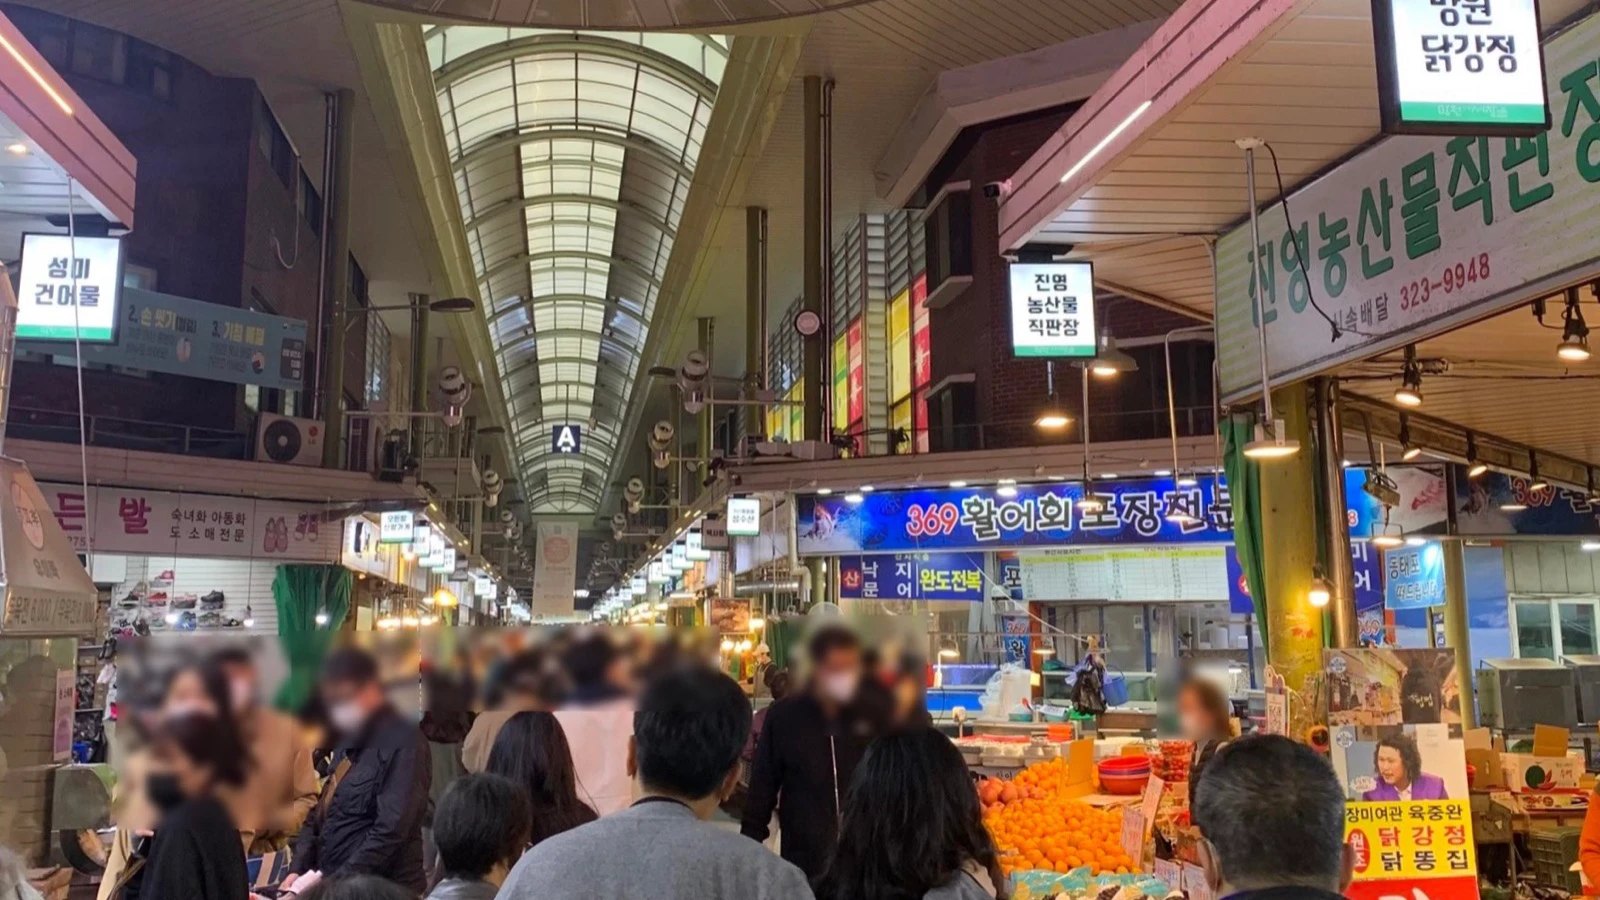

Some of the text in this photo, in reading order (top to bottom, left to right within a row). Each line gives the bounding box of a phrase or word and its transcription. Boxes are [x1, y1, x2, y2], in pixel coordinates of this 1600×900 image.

[1421, 35, 1518, 73] 닭강정
[48, 257, 91, 279] 성미
[1034, 273, 1068, 292] 진영
[1400, 253, 1490, 311] 323-9948
[34, 284, 100, 307] 건어물
[1028, 296, 1078, 315] 농산물
[1028, 319, 1080, 337] 직판장
[556, 426, 576, 447] A
[171, 508, 246, 526] 숙녀화 아동화
[905, 502, 961, 537] 369
[962, 493, 1074, 541] 활어회
[1389, 554, 1420, 579] 동태포
[920, 568, 983, 592] 완도전복
[1346, 804, 1463, 822] 장미여관 육중완
